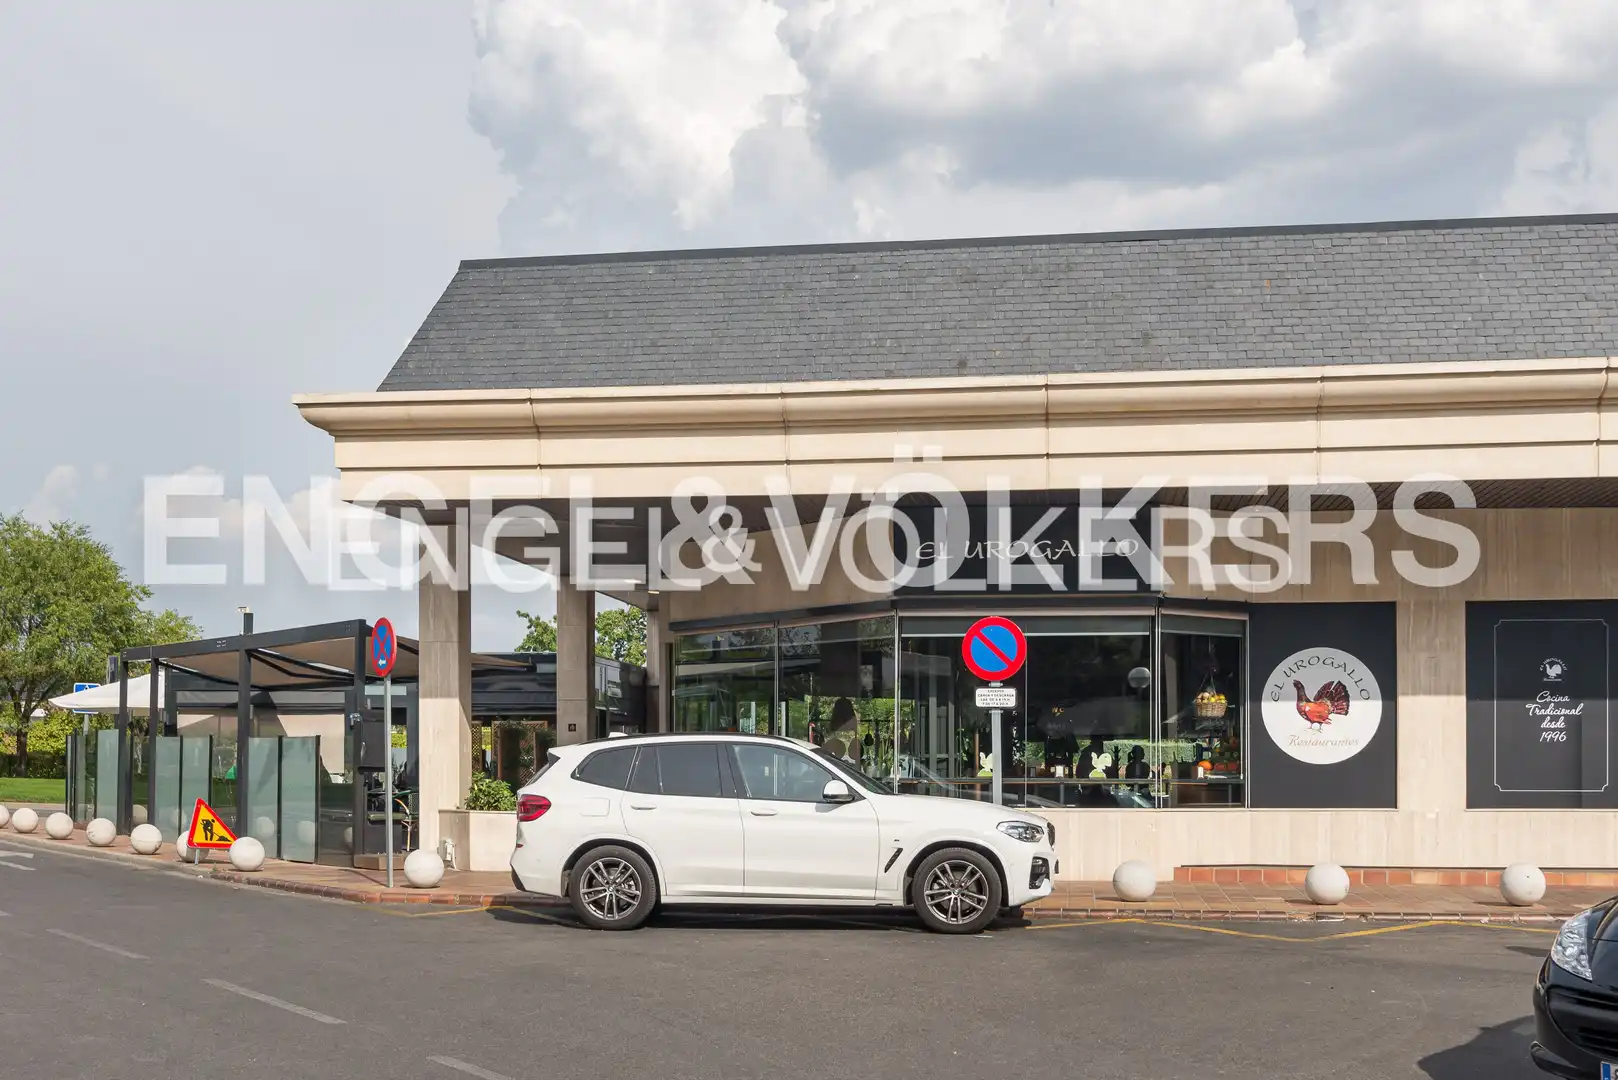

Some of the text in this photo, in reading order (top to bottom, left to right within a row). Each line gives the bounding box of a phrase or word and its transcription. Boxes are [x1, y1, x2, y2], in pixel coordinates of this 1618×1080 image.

[963, 538, 1140, 561] UROGALLO
[1282, 655, 1371, 701] UROGALLO
[1536, 690, 1571, 703] Cocina
[1525, 702, 1585, 716] Tradicional
[1540, 716, 1567, 729] desde
[1539, 731, 1567, 742] 1996
